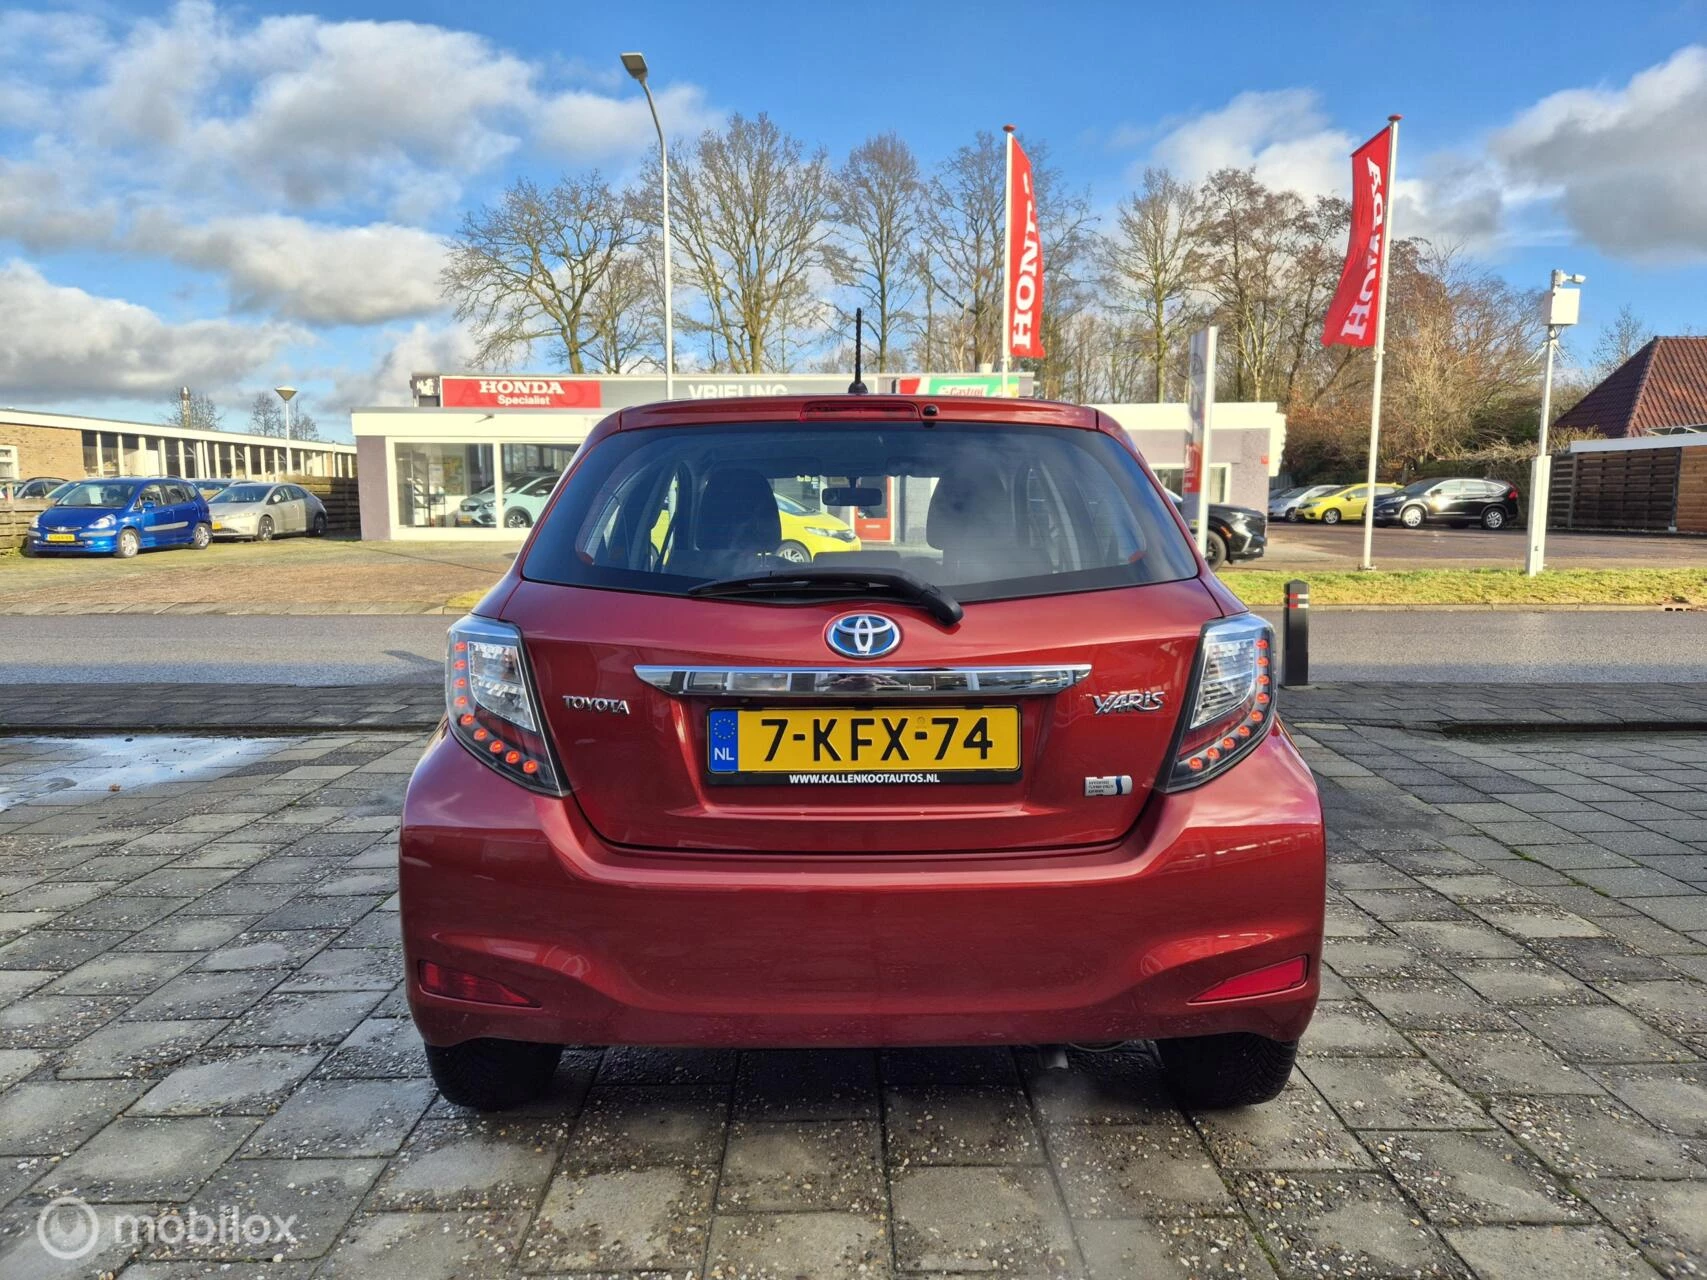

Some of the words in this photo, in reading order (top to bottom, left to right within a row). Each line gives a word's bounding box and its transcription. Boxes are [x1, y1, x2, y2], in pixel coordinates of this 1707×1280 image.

[479, 380, 565, 394] HONDA
[497, 394, 550, 406] Specialist
[562, 695, 630, 715] TOYOTA
[1093, 691, 1165, 714] YARIS
[760, 717, 993, 762] 7-KFX-74
[714, 747, 735, 761] NL
[789, 773, 941, 784] WWW.KALLENKOOTAUTOS.NL
